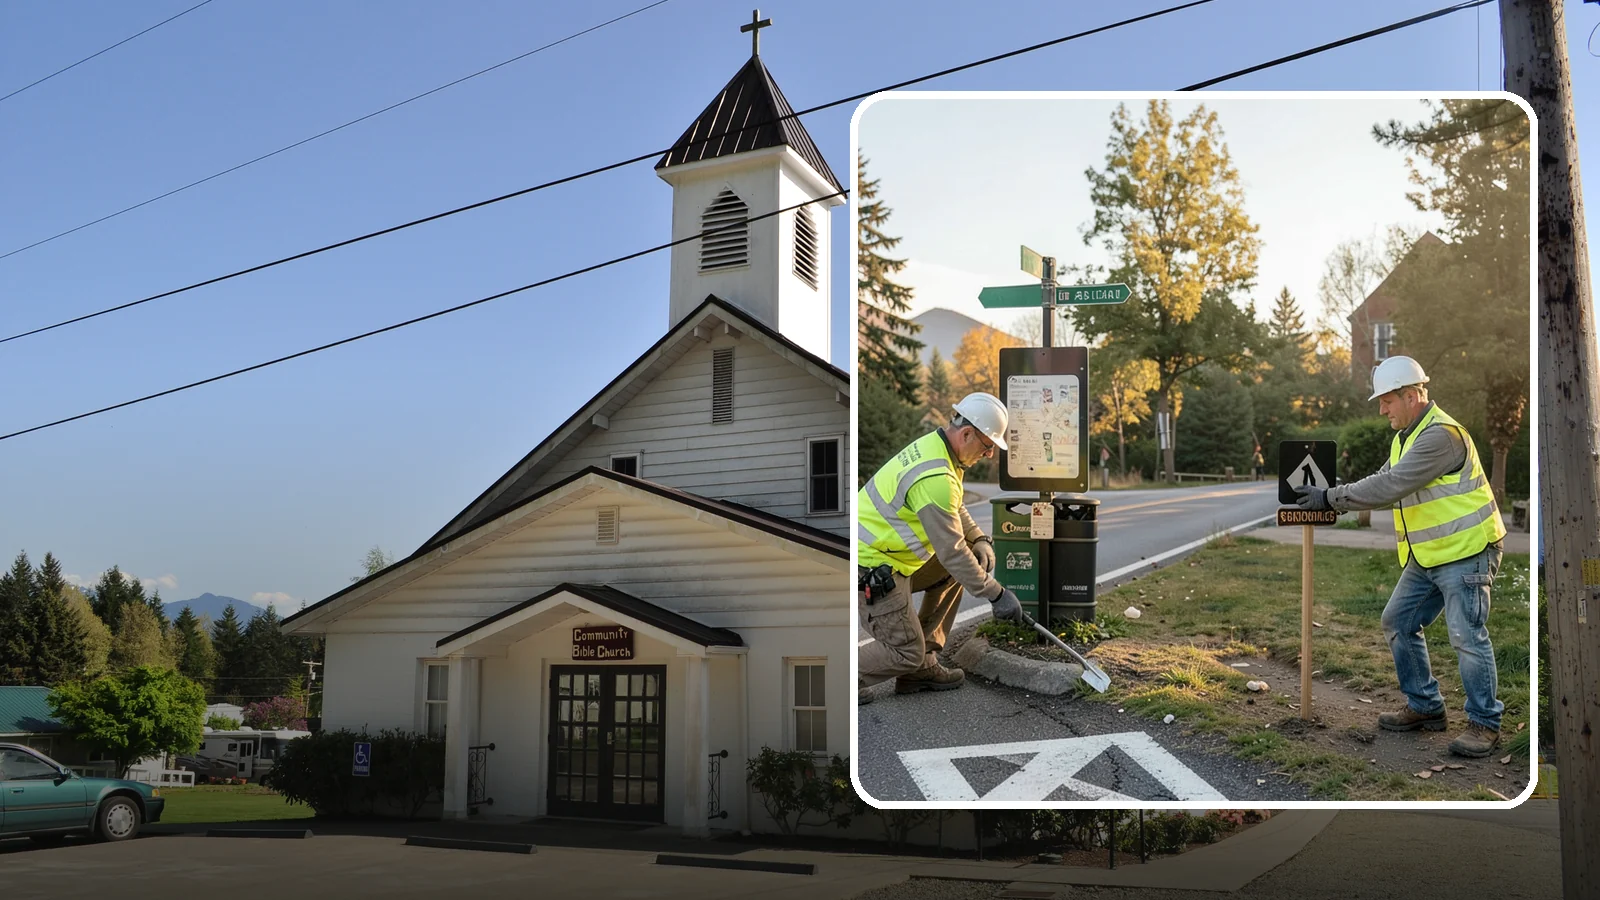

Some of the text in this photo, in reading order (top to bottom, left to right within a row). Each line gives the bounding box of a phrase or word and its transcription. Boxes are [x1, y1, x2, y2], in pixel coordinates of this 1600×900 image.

[574, 627, 628, 642] Community
[572, 644, 631, 658] Bible Church
